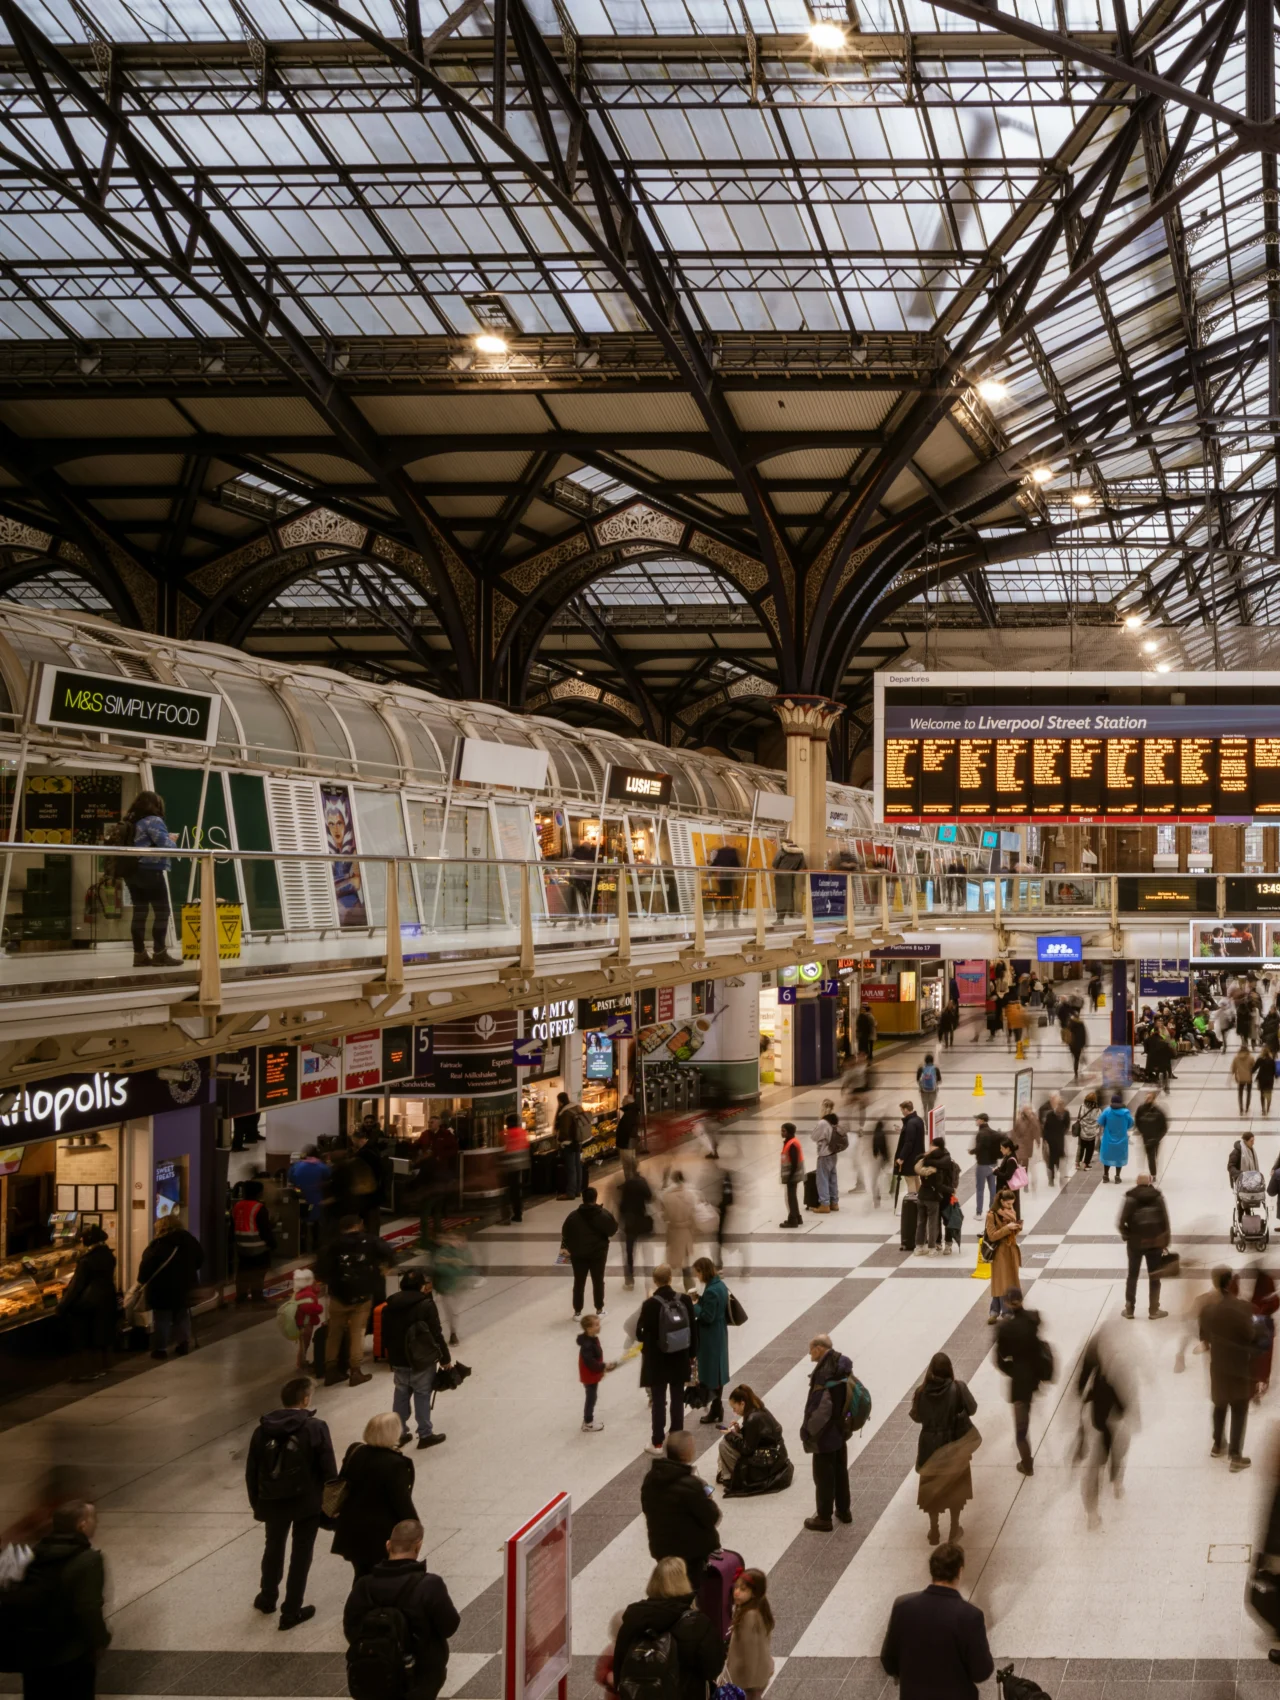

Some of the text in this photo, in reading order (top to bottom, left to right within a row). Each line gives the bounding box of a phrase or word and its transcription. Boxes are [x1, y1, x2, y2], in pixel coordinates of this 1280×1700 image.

[889, 675, 930, 684] Departures
[64, 688, 200, 727] M&S SIMPLY FOOD
[909, 715, 1147, 733] Welcome to Liverpool Street Station
[626, 776, 650, 794] LUSH
[707, 981, 713, 998] 7
[782, 989, 791, 1001] 6
[826, 982, 834, 993] 7
[540, 999, 567, 1019] AMT
[532, 1017, 576, 1040] COFFEE
[419, 1028, 429, 1053] 5
[235, 1057, 251, 1086] 4
[464, 1071, 497, 1079] Milkshakes
[156, 1164, 175, 1175] SWEET
[156, 1171, 176, 1182] TREATS
